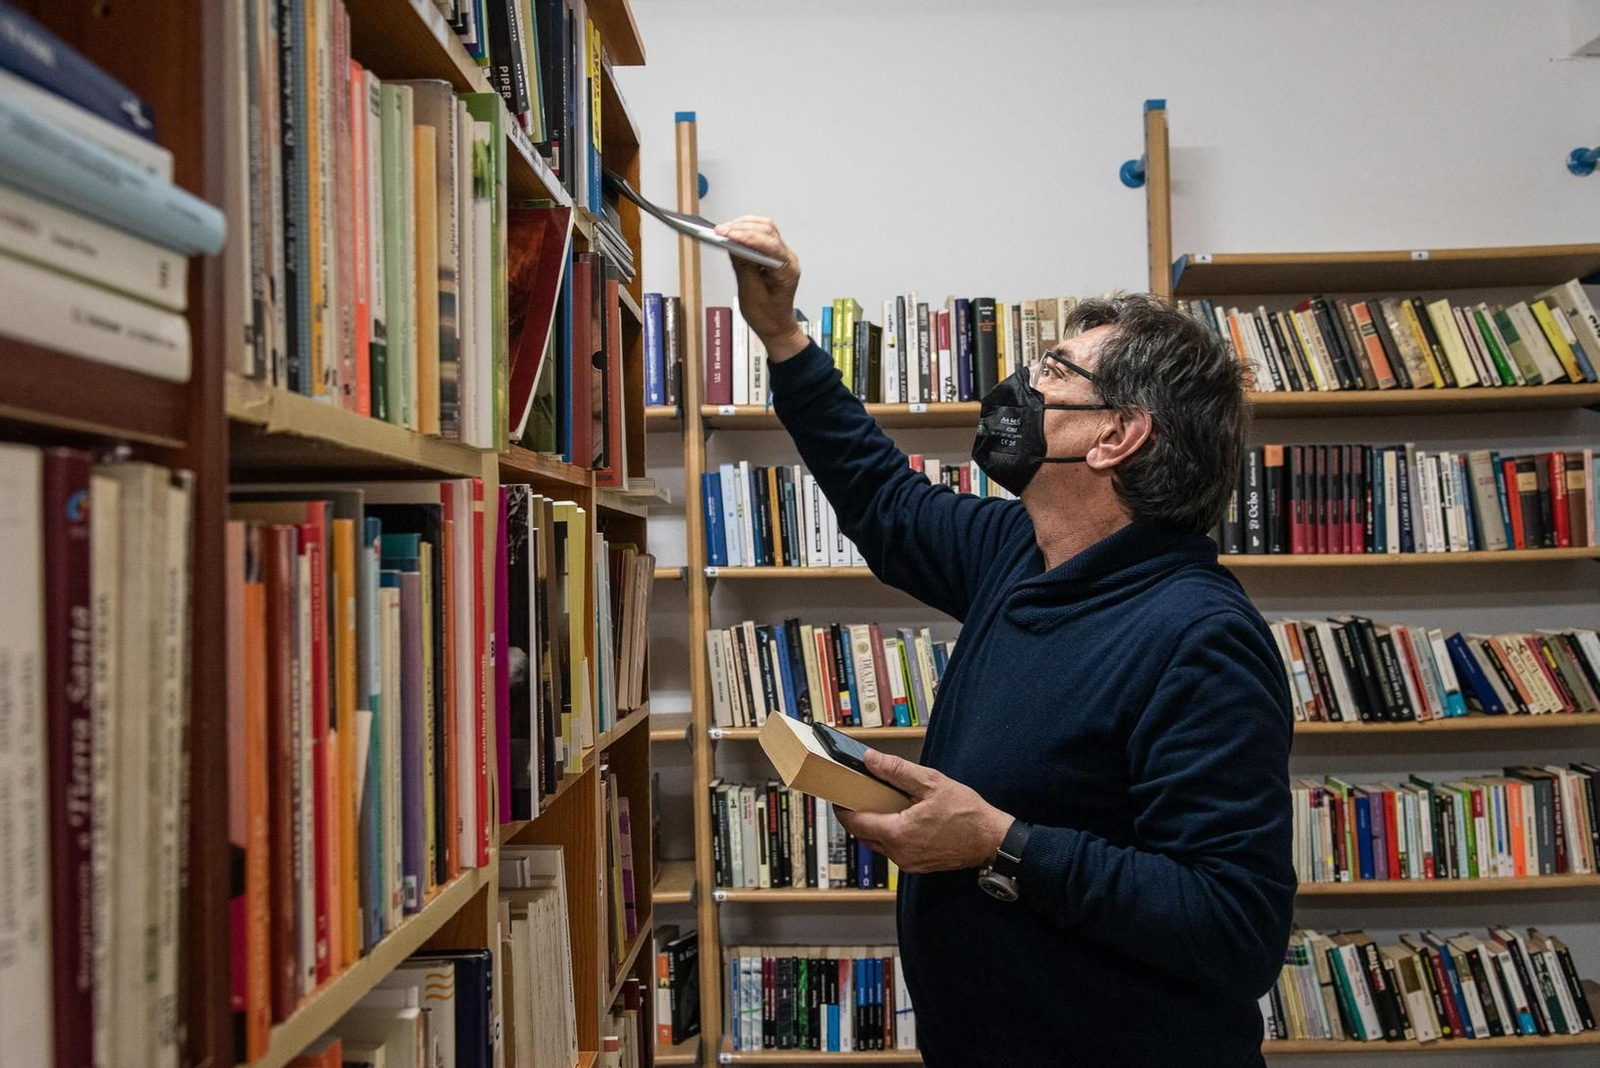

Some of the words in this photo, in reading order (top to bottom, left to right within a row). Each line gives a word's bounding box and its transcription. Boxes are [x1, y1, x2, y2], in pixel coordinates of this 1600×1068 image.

[500, 65, 511, 99] PIPER
[1247, 491, 1259, 518] Ocho
[864, 656, 876, 699] LOUVRE
